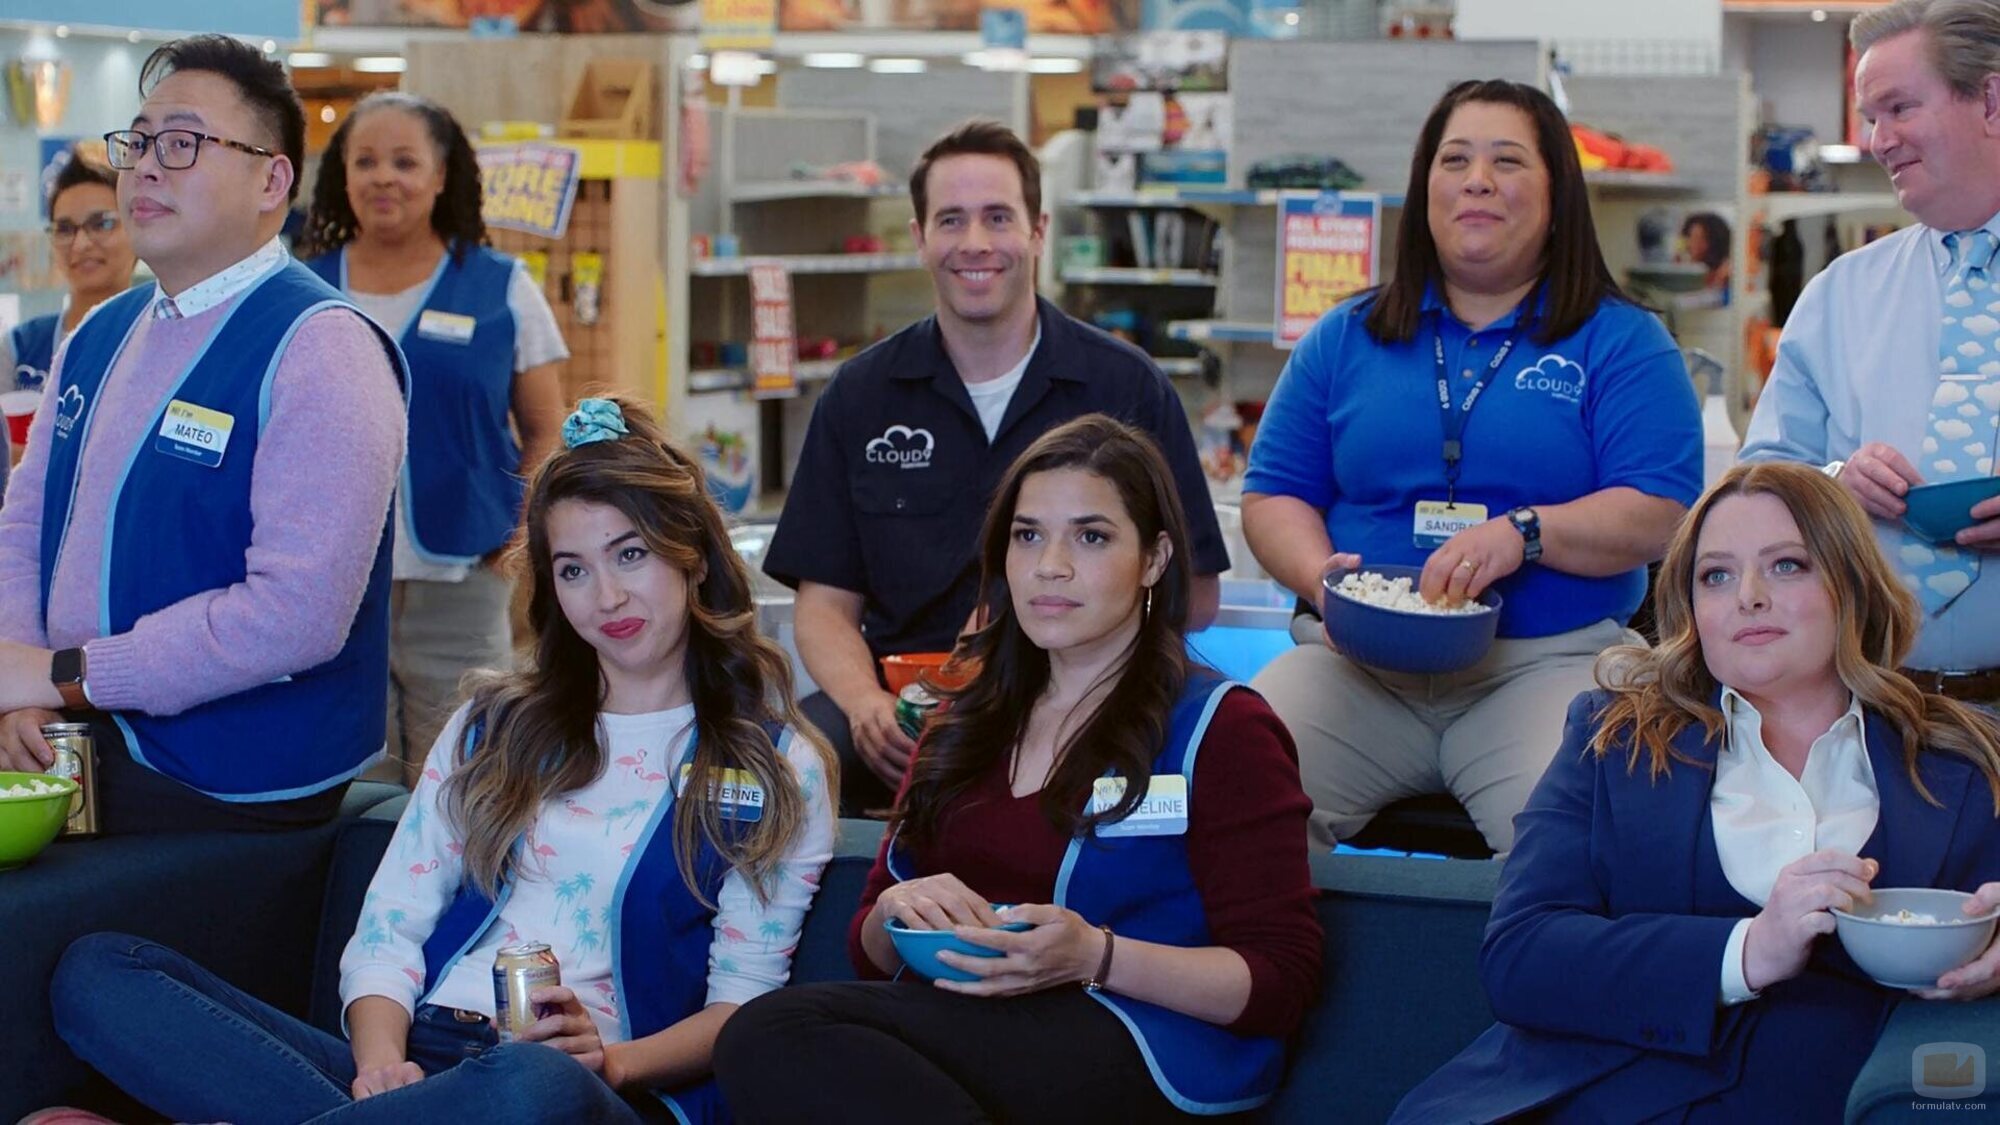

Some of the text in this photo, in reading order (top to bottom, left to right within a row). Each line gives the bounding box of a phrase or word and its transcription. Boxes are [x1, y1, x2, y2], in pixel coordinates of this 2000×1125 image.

[1285, 251, 1363, 284] FINAL
[1284, 282, 1350, 314] DAY
[174, 423, 214, 445] MATEO
[865, 448, 933, 464] CLOUD9
[1096, 799, 1184, 815] VELINE
